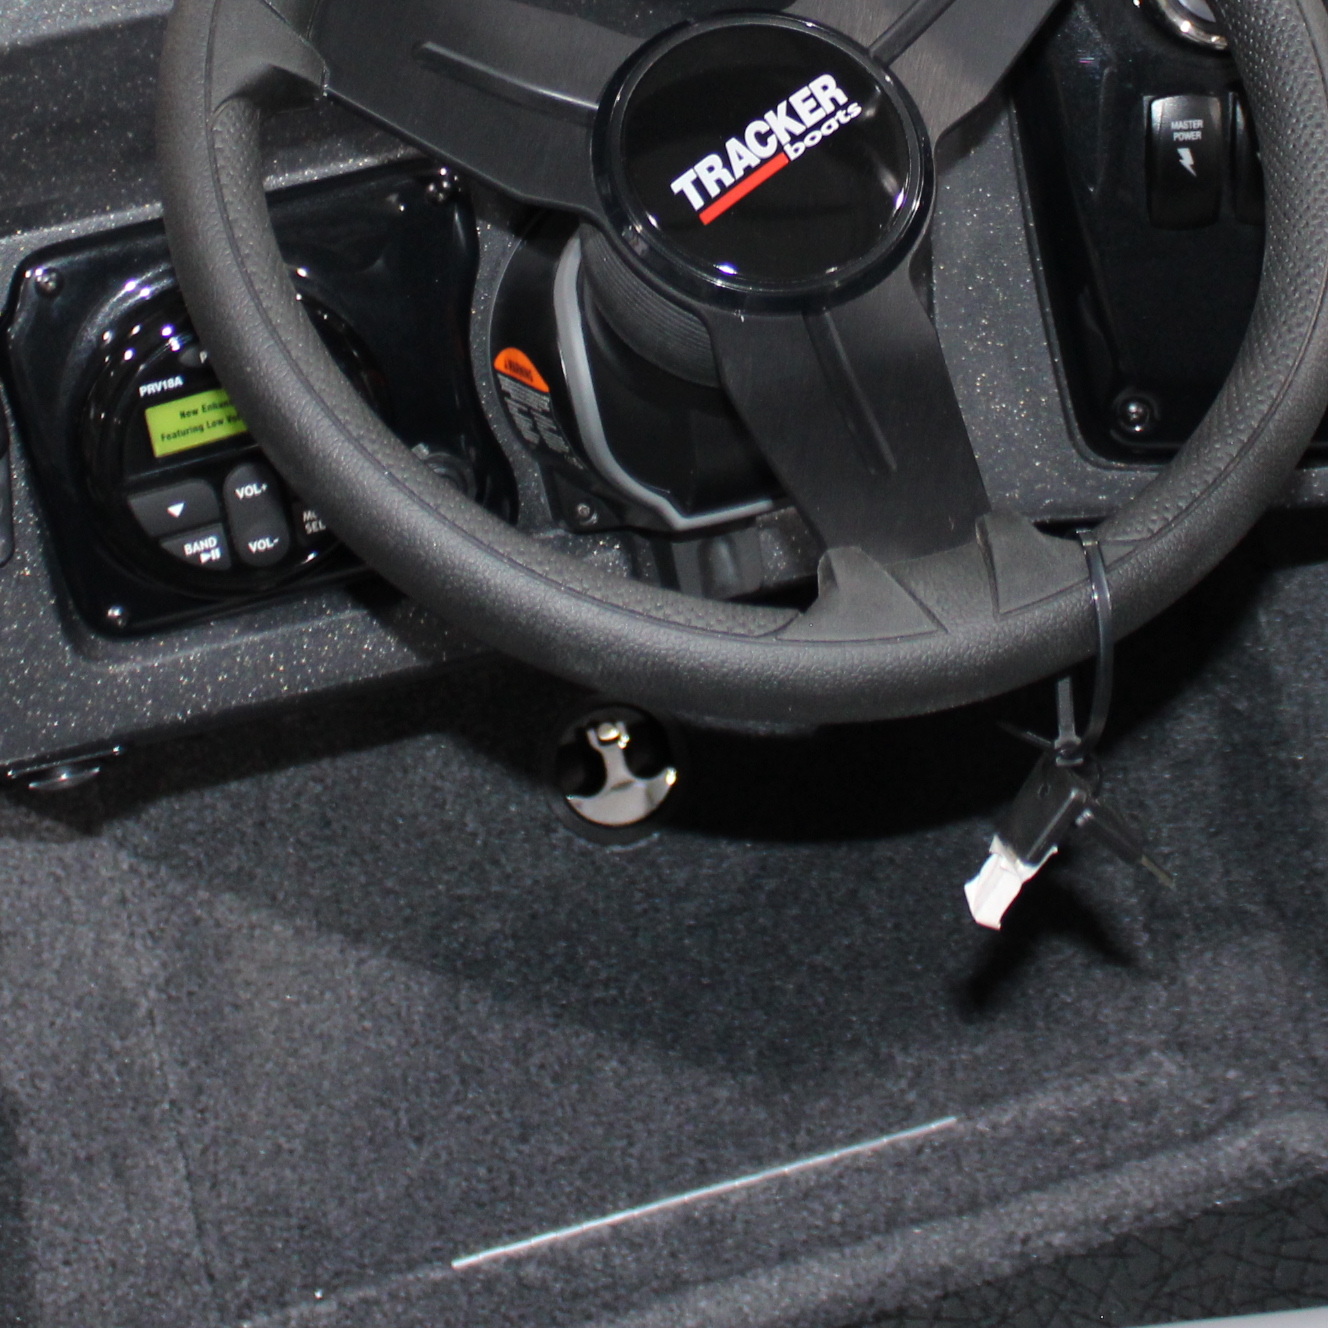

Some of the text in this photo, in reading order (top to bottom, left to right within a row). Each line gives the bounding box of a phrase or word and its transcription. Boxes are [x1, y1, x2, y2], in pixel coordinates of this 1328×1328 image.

[783, 102, 863, 162] boats
[1171, 118, 1204, 130] MASTER
[671, 74, 849, 211] TRACKER
[1173, 130, 1202, 142] POWER
[139, 375, 184, 397] PRV18A
[179, 408, 199, 420] New
[160, 423, 205, 442] Featuring
[206, 418, 225, 429] Low
[235, 483, 268, 500] VOL+
[184, 536, 218, 556] BAND
